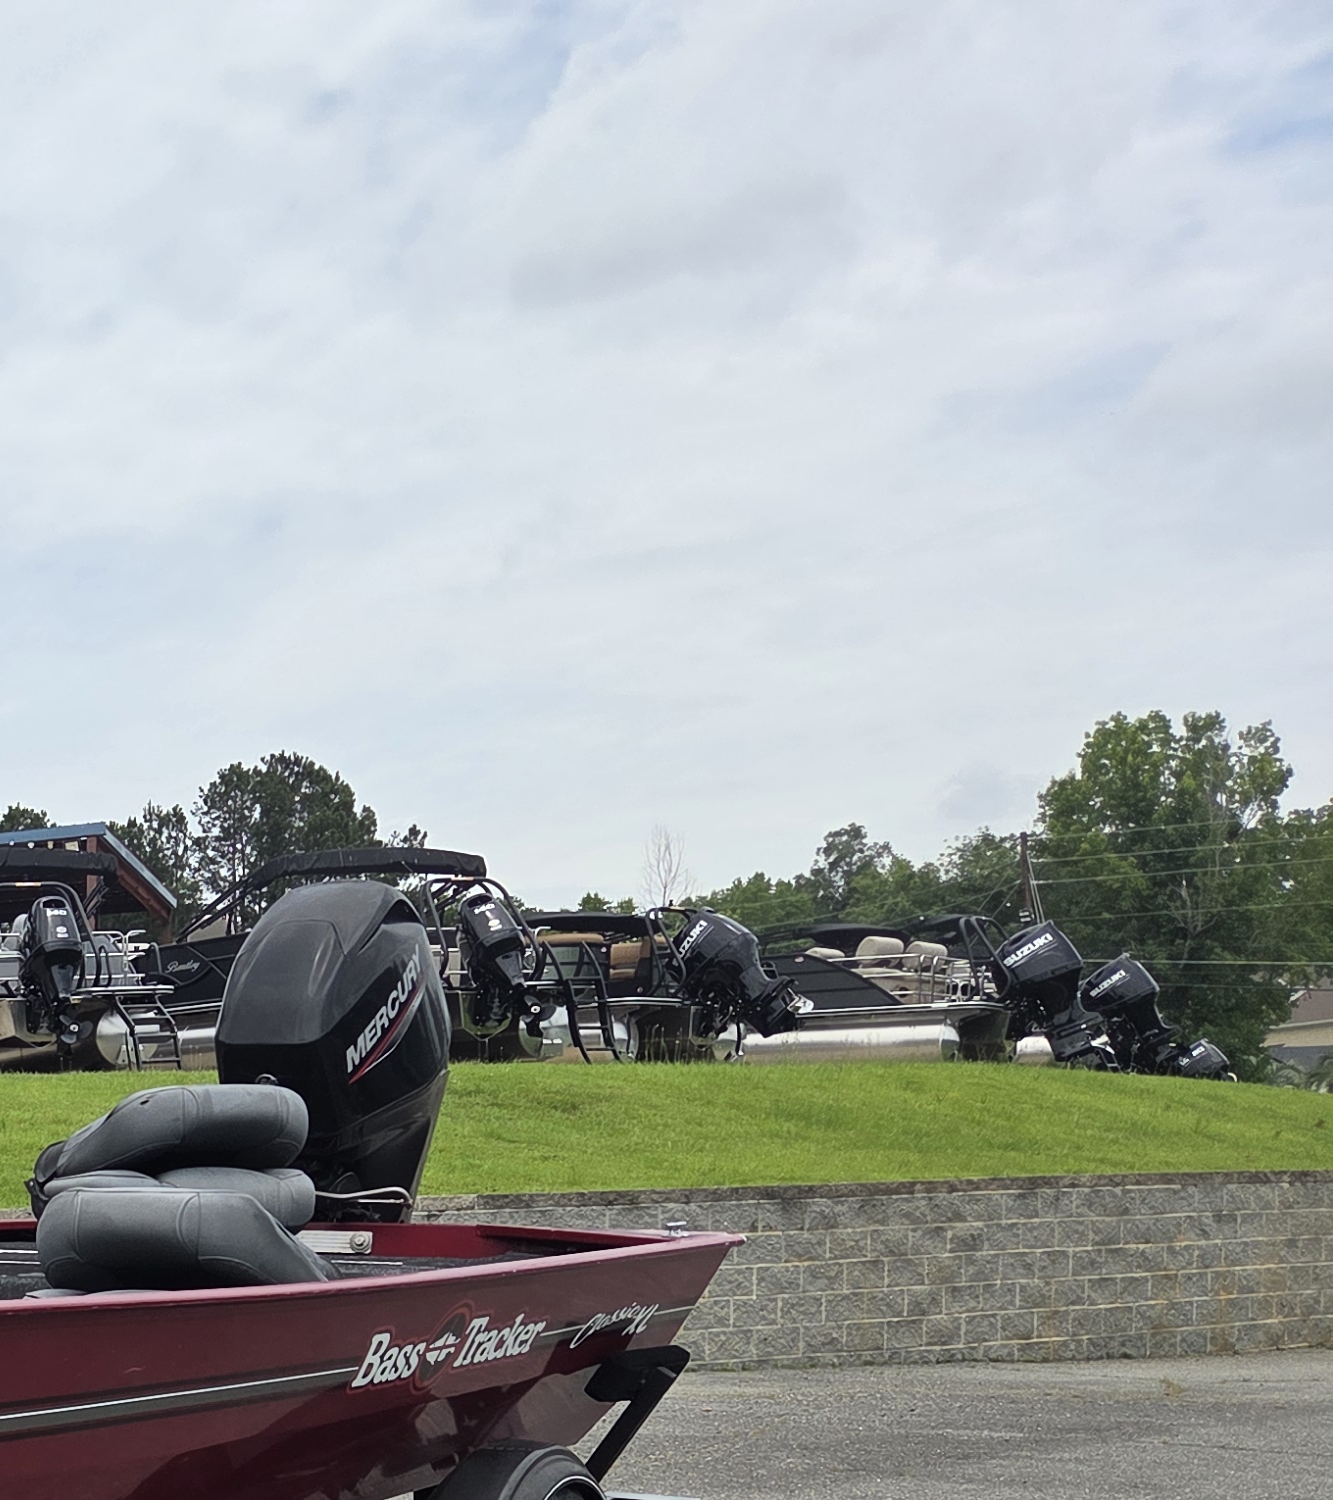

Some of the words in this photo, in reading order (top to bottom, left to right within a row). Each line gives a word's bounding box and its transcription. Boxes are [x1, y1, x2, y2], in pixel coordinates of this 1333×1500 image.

[677, 919, 709, 960] UZUKI
[1003, 932, 1054, 967] SUZUKI
[1089, 969, 1127, 998] SUZUKI
[345, 942, 422, 1074] MERCURY
[351, 1332, 425, 1388] Bass
[453, 1313, 547, 1368] Tracker
